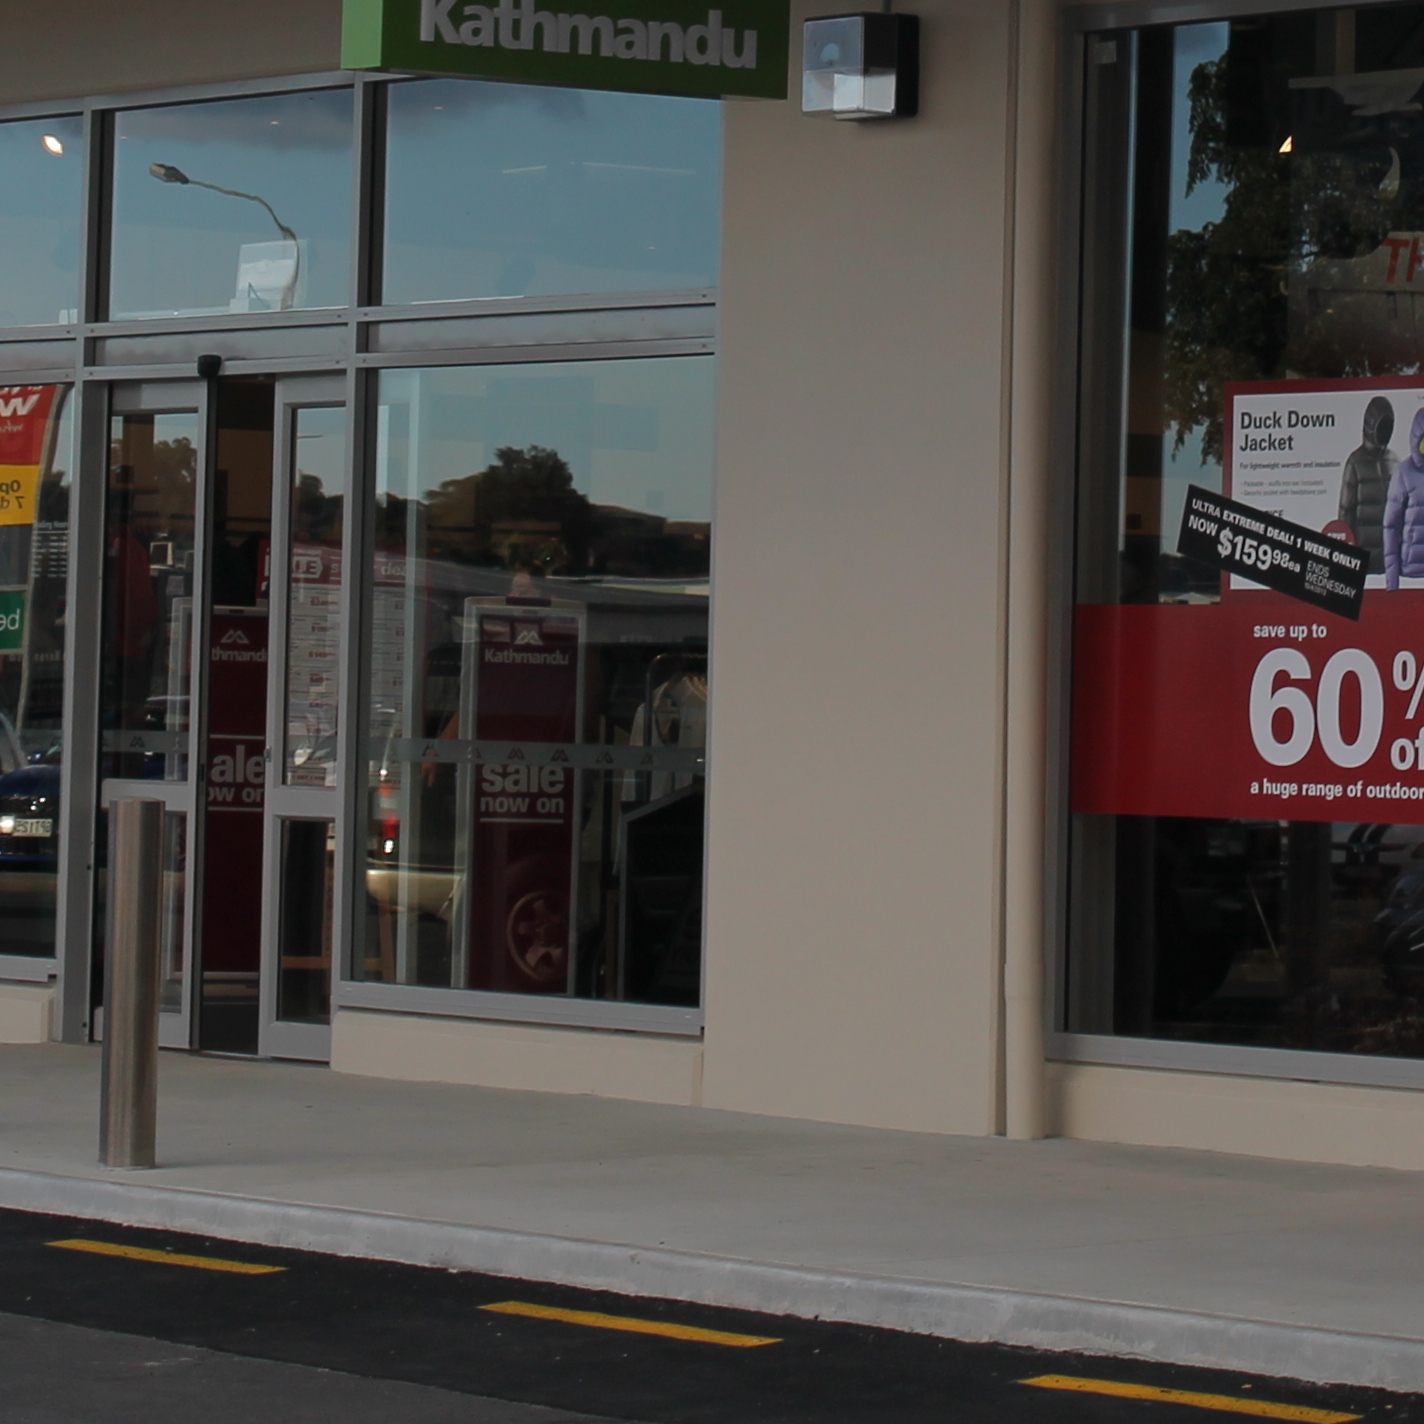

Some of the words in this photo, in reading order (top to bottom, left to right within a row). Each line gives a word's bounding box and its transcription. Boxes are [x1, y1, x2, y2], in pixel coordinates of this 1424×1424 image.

[1240, 411, 1282, 430] Duck
[1287, 410, 1335, 428] Down
[1239, 434, 1294, 452] Jacket
[1188, 514, 1218, 537] NOW
[1192, 498, 1221, 518] ULTRA
[1222, 509, 1265, 535] EXTREME
[1266, 525, 1295, 545] DEAL!
[1303, 540, 1331, 560] WEEK
[1332, 551, 1361, 570] ONLY!
[1307, 560, 1330, 577] ENDS
[1305, 571, 1357, 599] WEDNESDAY
[1253, 625, 1285, 639] save
[1289, 624, 1308, 642] up
[1311, 622, 1327, 638] to
[211, 646, 269, 662] thmand
[485, 648, 569, 666] Kathmandu
[210, 744, 265, 785] ale
[482, 763, 565, 794] sale
[207, 787, 235, 802] ow
[1250, 782, 1259, 795] a
[1262, 778, 1298, 800] huge
[1301, 782, 1344, 802] range
[1347, 779, 1364, 799] of
[1366, 781, 1424, 800] outdoor
[480, 796, 530, 813] now
[536, 797, 566, 814] on
